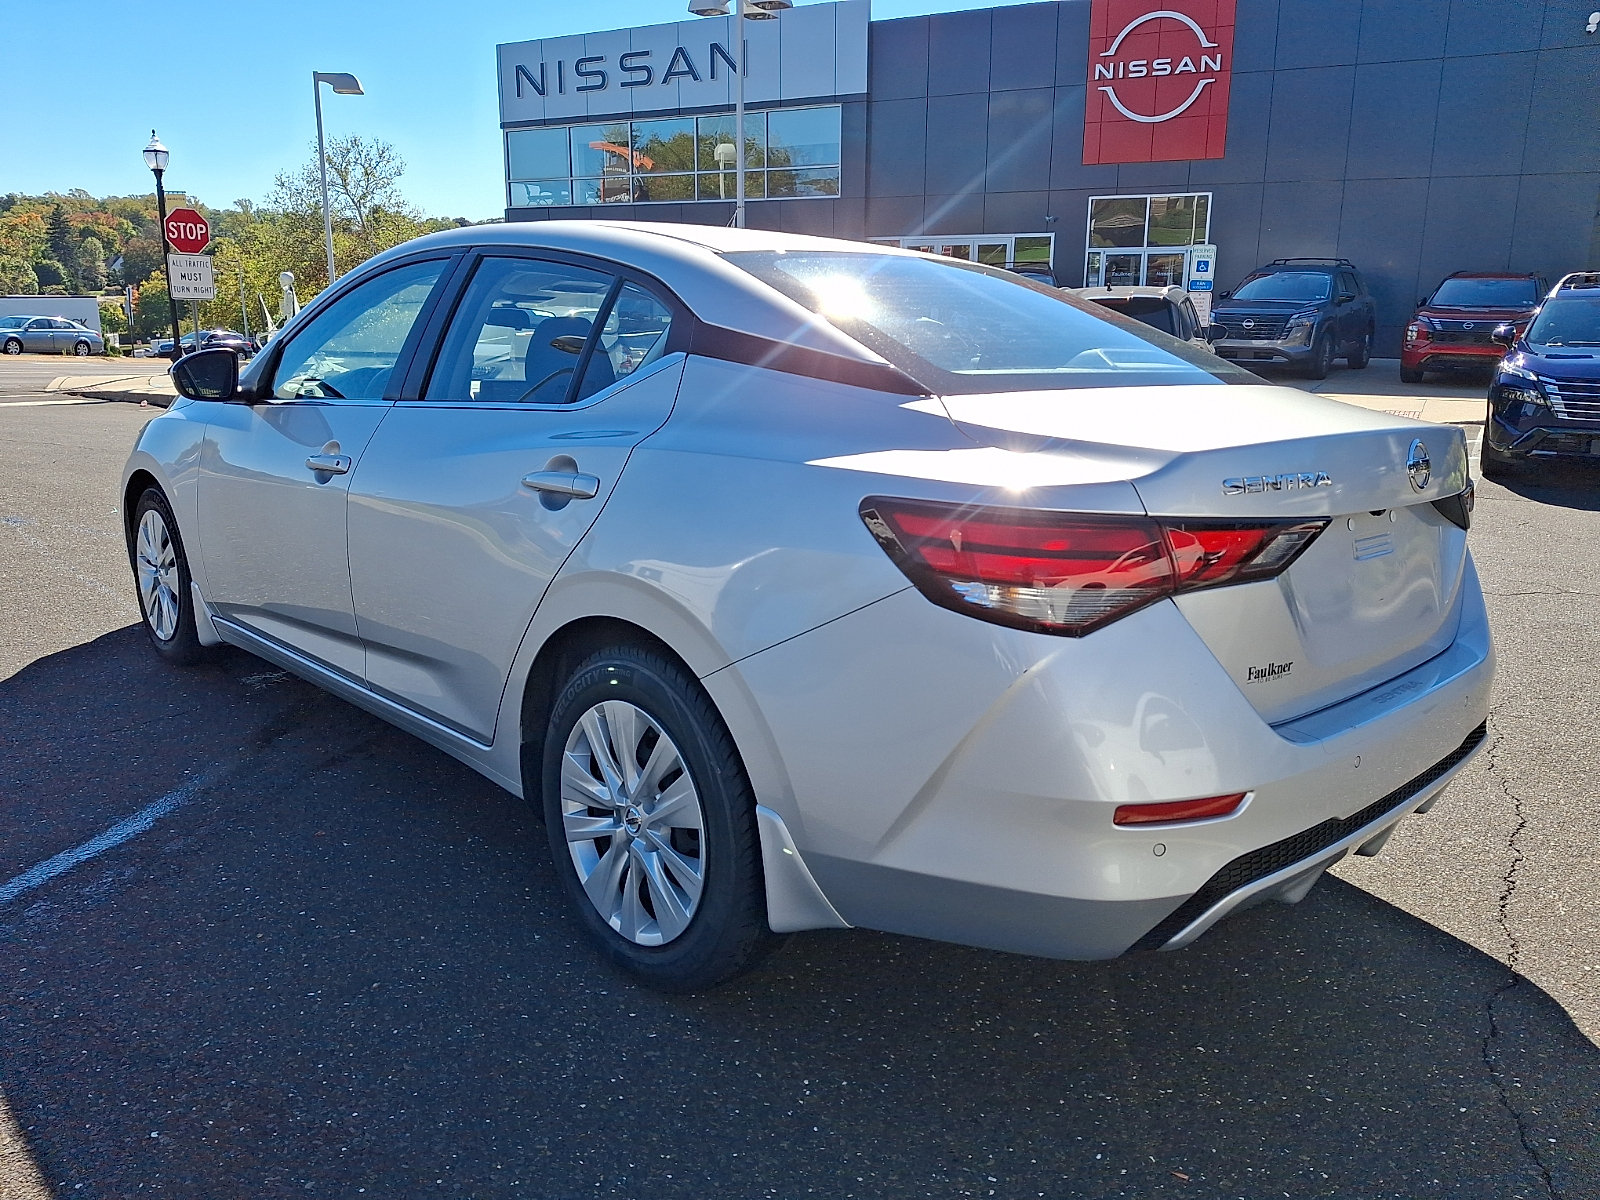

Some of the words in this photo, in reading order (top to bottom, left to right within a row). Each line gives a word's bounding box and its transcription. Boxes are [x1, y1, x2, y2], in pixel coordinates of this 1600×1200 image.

[514, 39, 749, 98] NISSAN
[1094, 53, 1222, 81] NISSAN
[168, 221, 207, 240] STOP
[171, 259, 183, 268] ALL
[184, 259, 209, 269] TRAFFIC
[180, 272, 202, 282] MUST
[173, 285, 191, 294] TURN
[193, 286, 212, 295] RIGHT
[1222, 471, 1332, 496] SENTRA
[1247, 661, 1294, 681] Faulkner
